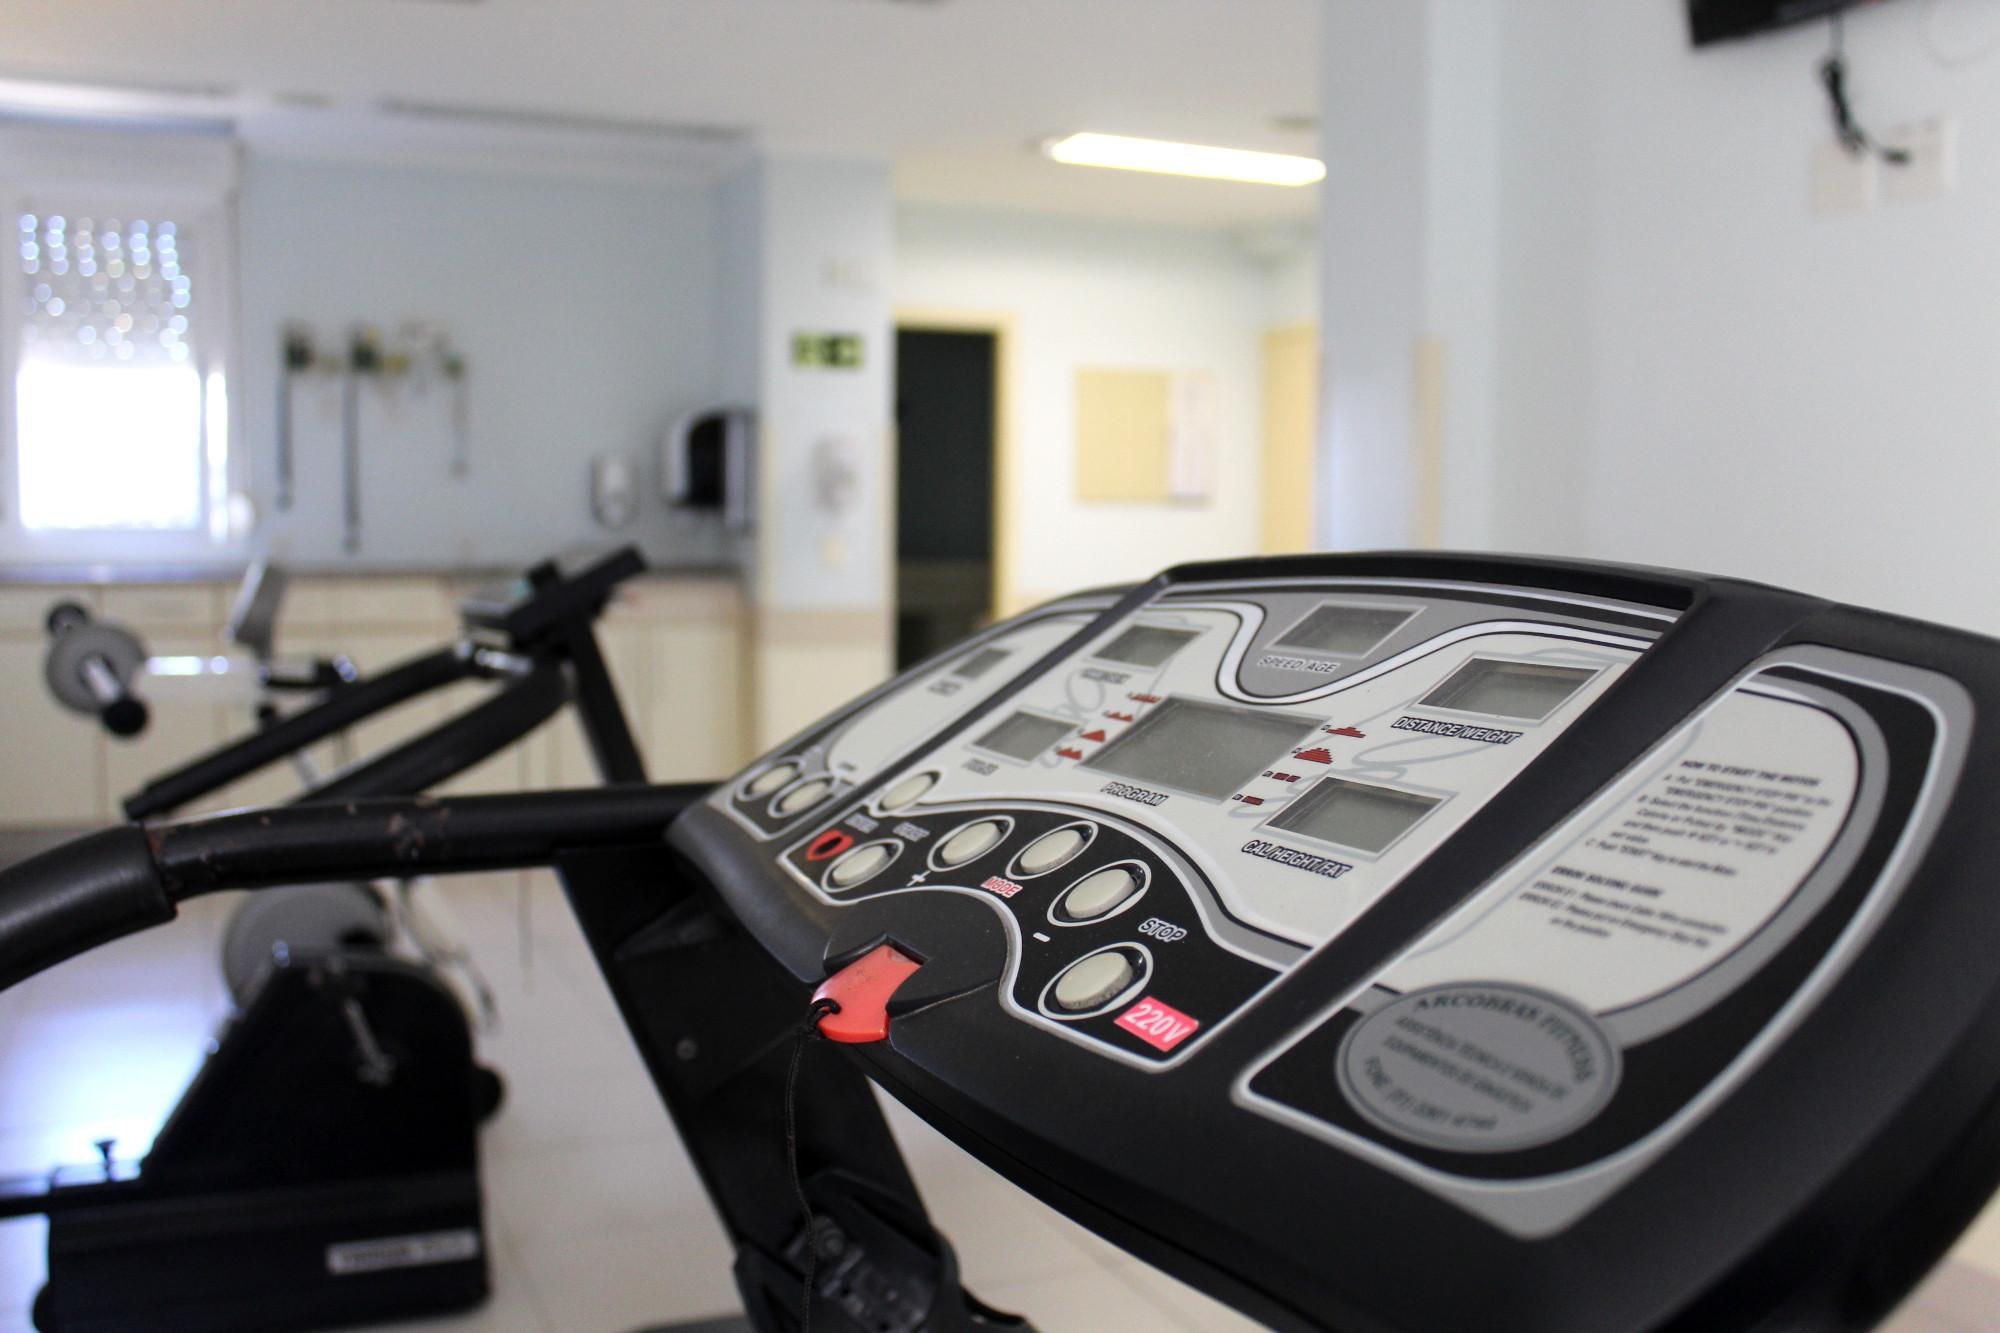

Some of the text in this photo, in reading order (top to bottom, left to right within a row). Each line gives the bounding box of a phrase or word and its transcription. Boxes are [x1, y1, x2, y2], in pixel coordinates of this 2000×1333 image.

[1391, 716, 1524, 745] DISTANCE/WEIGHT
[1100, 781, 1169, 807] PROGRAM
[1241, 839, 1354, 879] CAL/HEIGHT/FAT
[980, 876, 1023, 898] MODE
[1138, 917, 1187, 942] STOP
[1123, 1002, 1190, 1044] 220V
